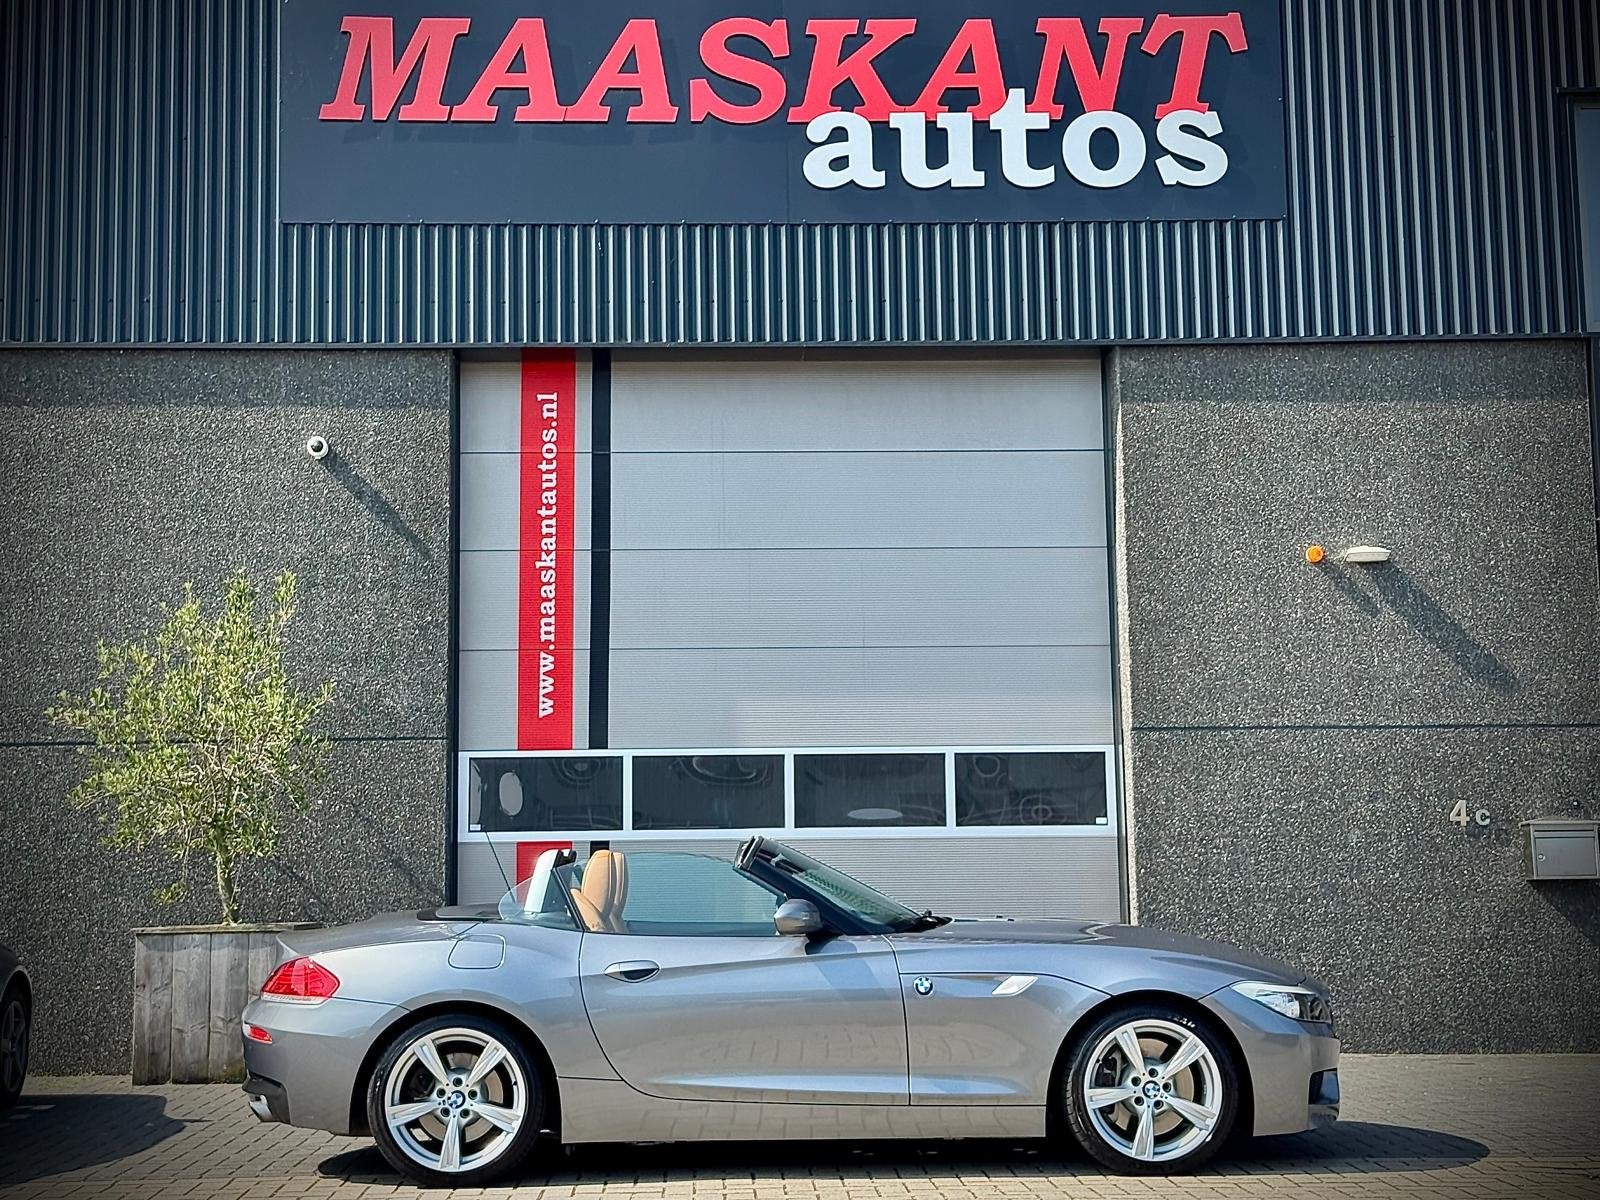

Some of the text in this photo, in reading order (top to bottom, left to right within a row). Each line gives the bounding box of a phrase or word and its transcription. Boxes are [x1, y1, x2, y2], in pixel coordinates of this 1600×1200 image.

[319, 11, 1249, 124] MAASKANT
[802, 87, 1229, 190] autos
[535, 392, 558, 718] www.maaskantautos.nl
